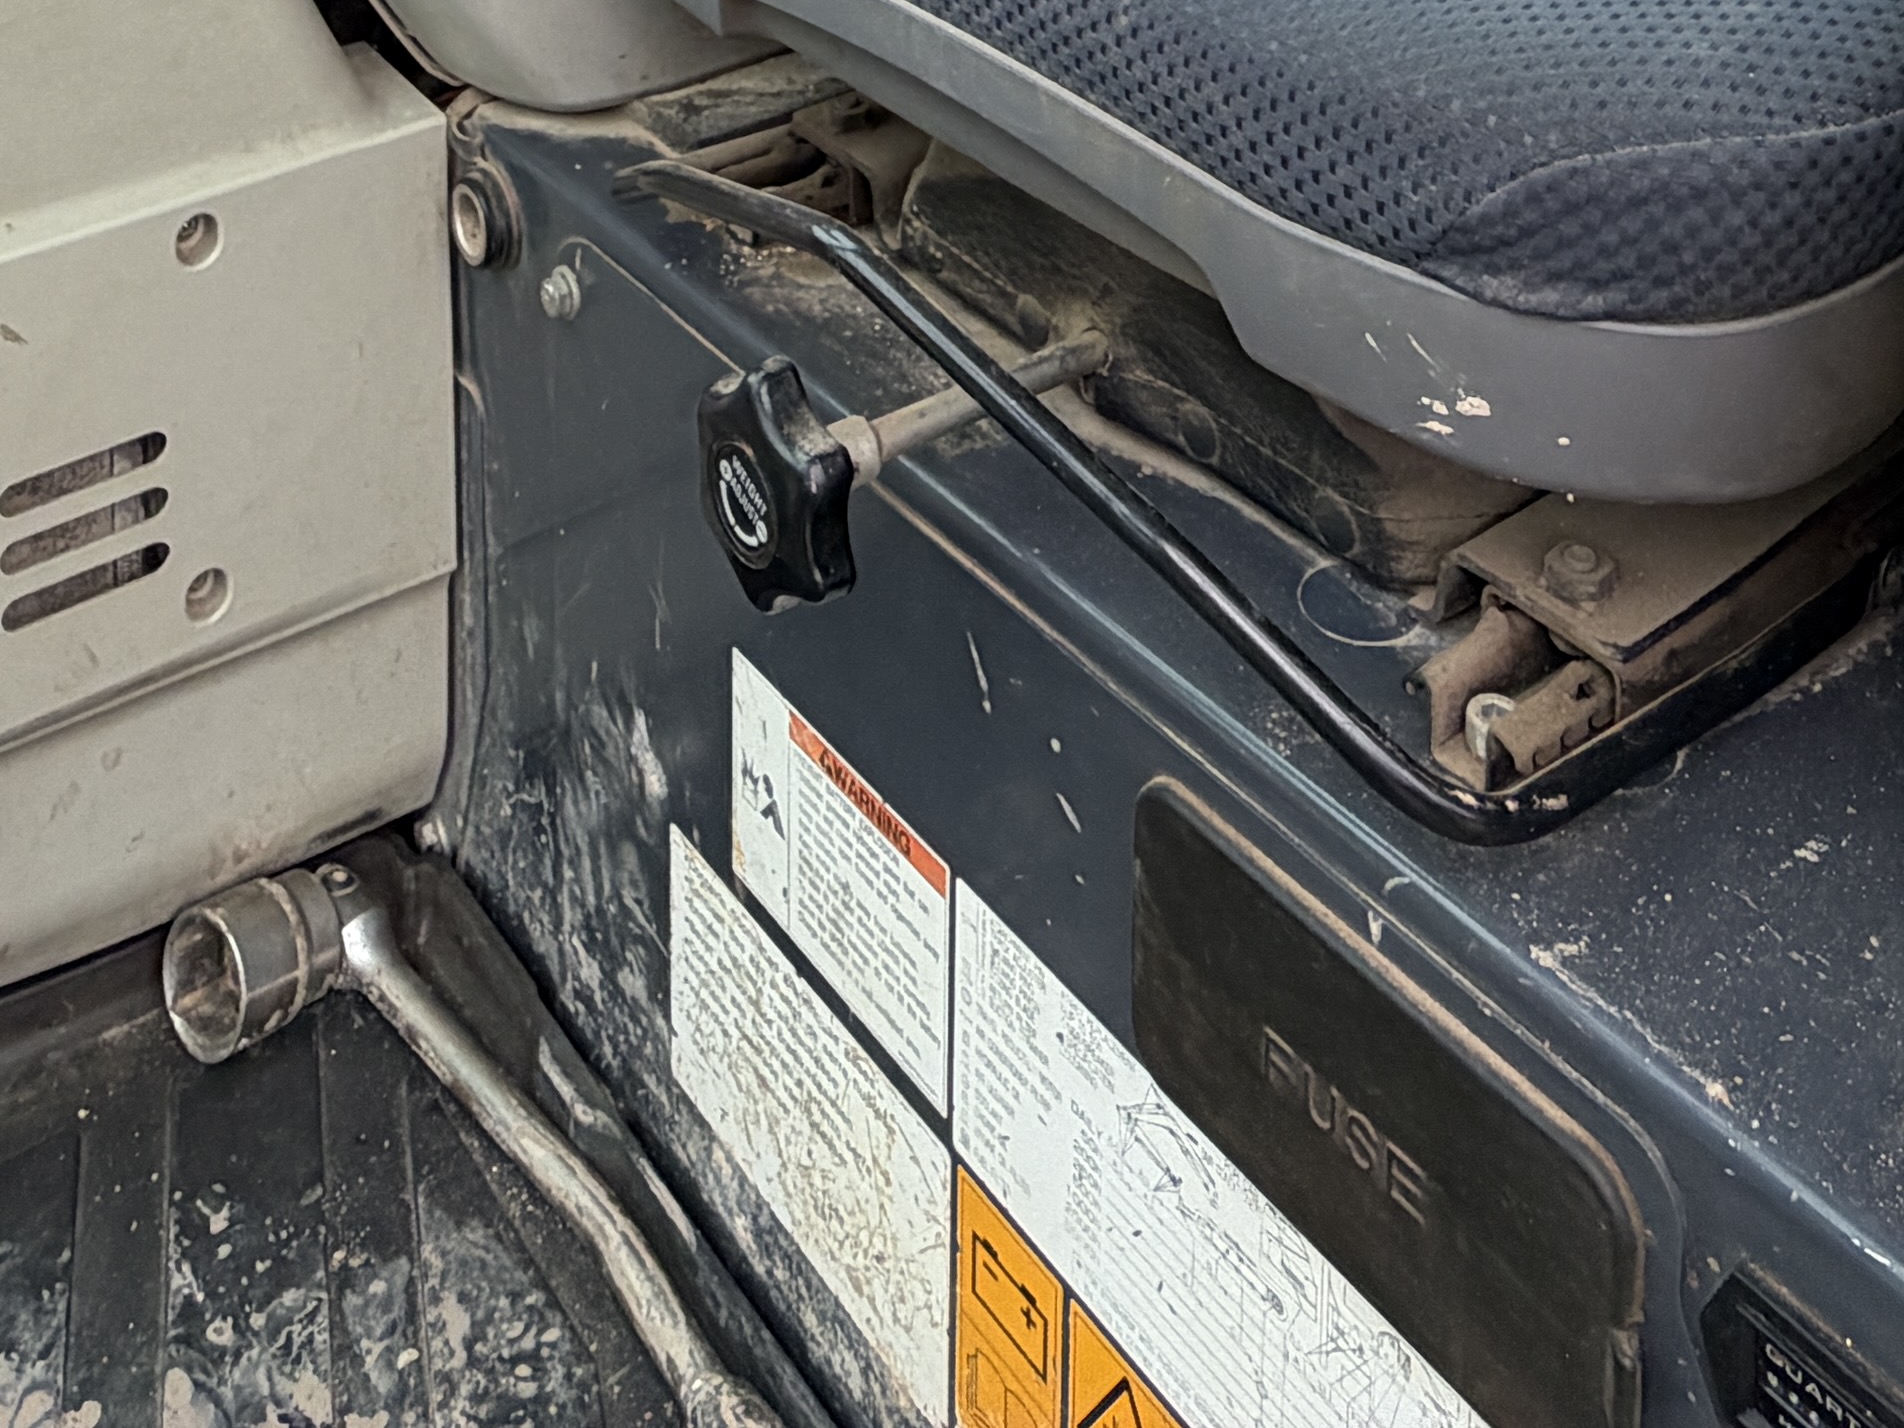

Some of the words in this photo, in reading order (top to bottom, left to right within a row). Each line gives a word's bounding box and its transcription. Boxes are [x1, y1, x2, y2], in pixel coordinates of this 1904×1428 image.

[730, 477, 759, 525] ADJUST
[732, 454, 768, 517] WEIGHT
[835, 760, 910, 860] WARNING
[1261, 1025, 1430, 1227] FUSE
